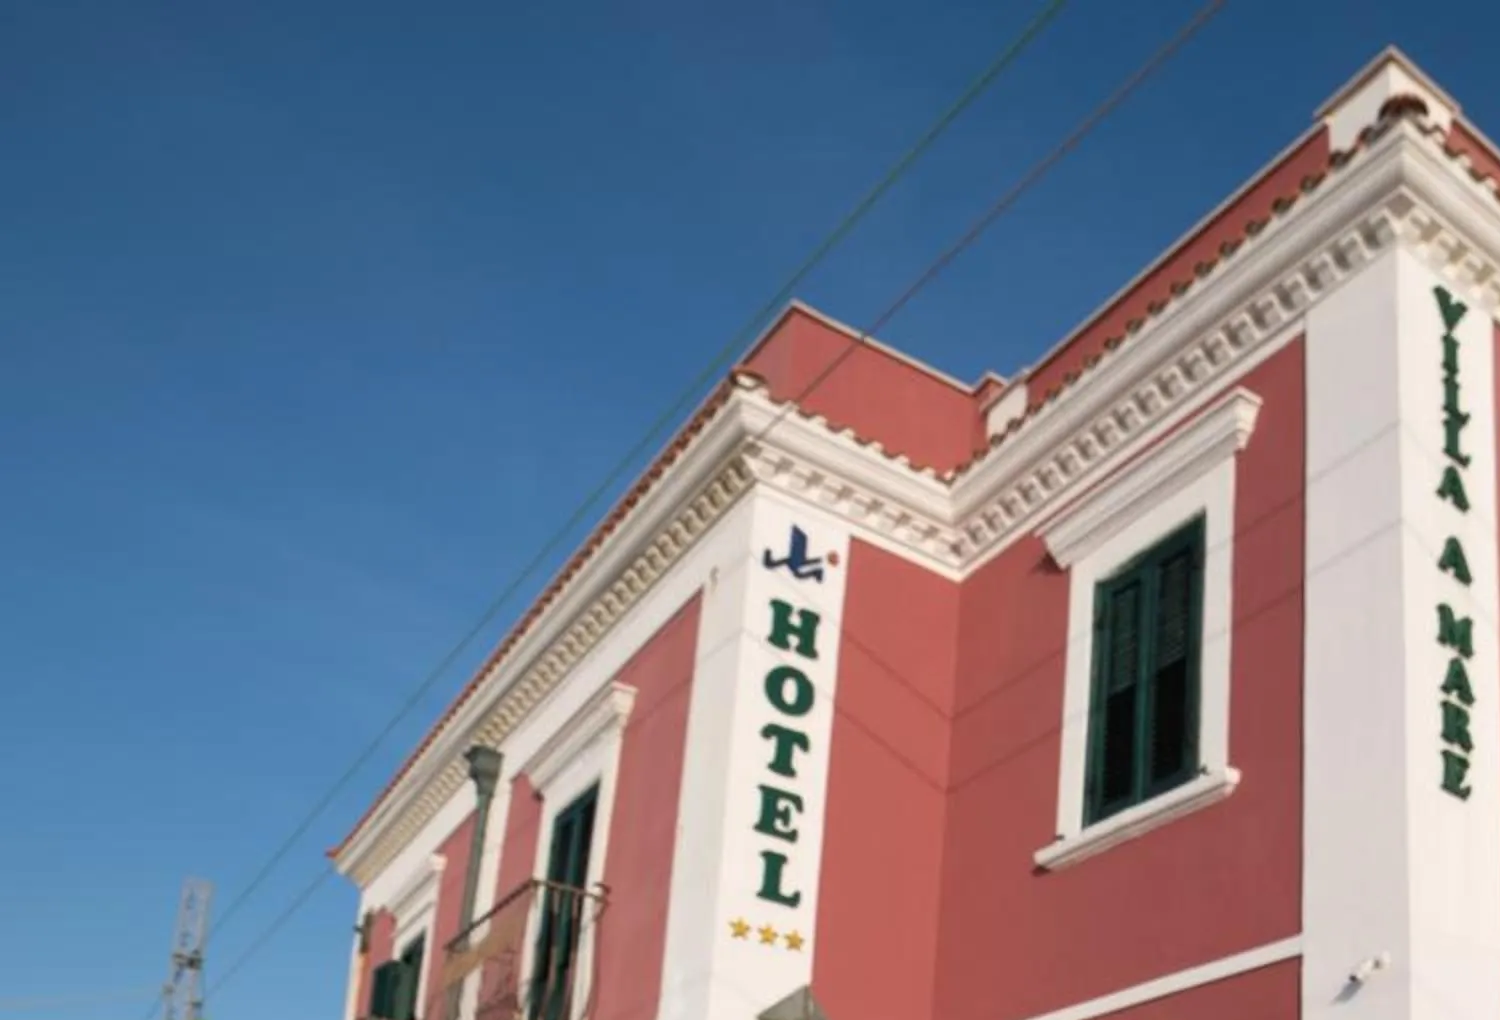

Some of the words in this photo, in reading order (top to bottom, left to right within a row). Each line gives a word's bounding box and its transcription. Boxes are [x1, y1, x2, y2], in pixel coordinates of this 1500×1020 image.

[1432, 285, 1471, 514] VILLA
[1436, 536, 1473, 587] A
[754, 598, 821, 909] HOTEL
[1436, 603, 1476, 802] MARE
